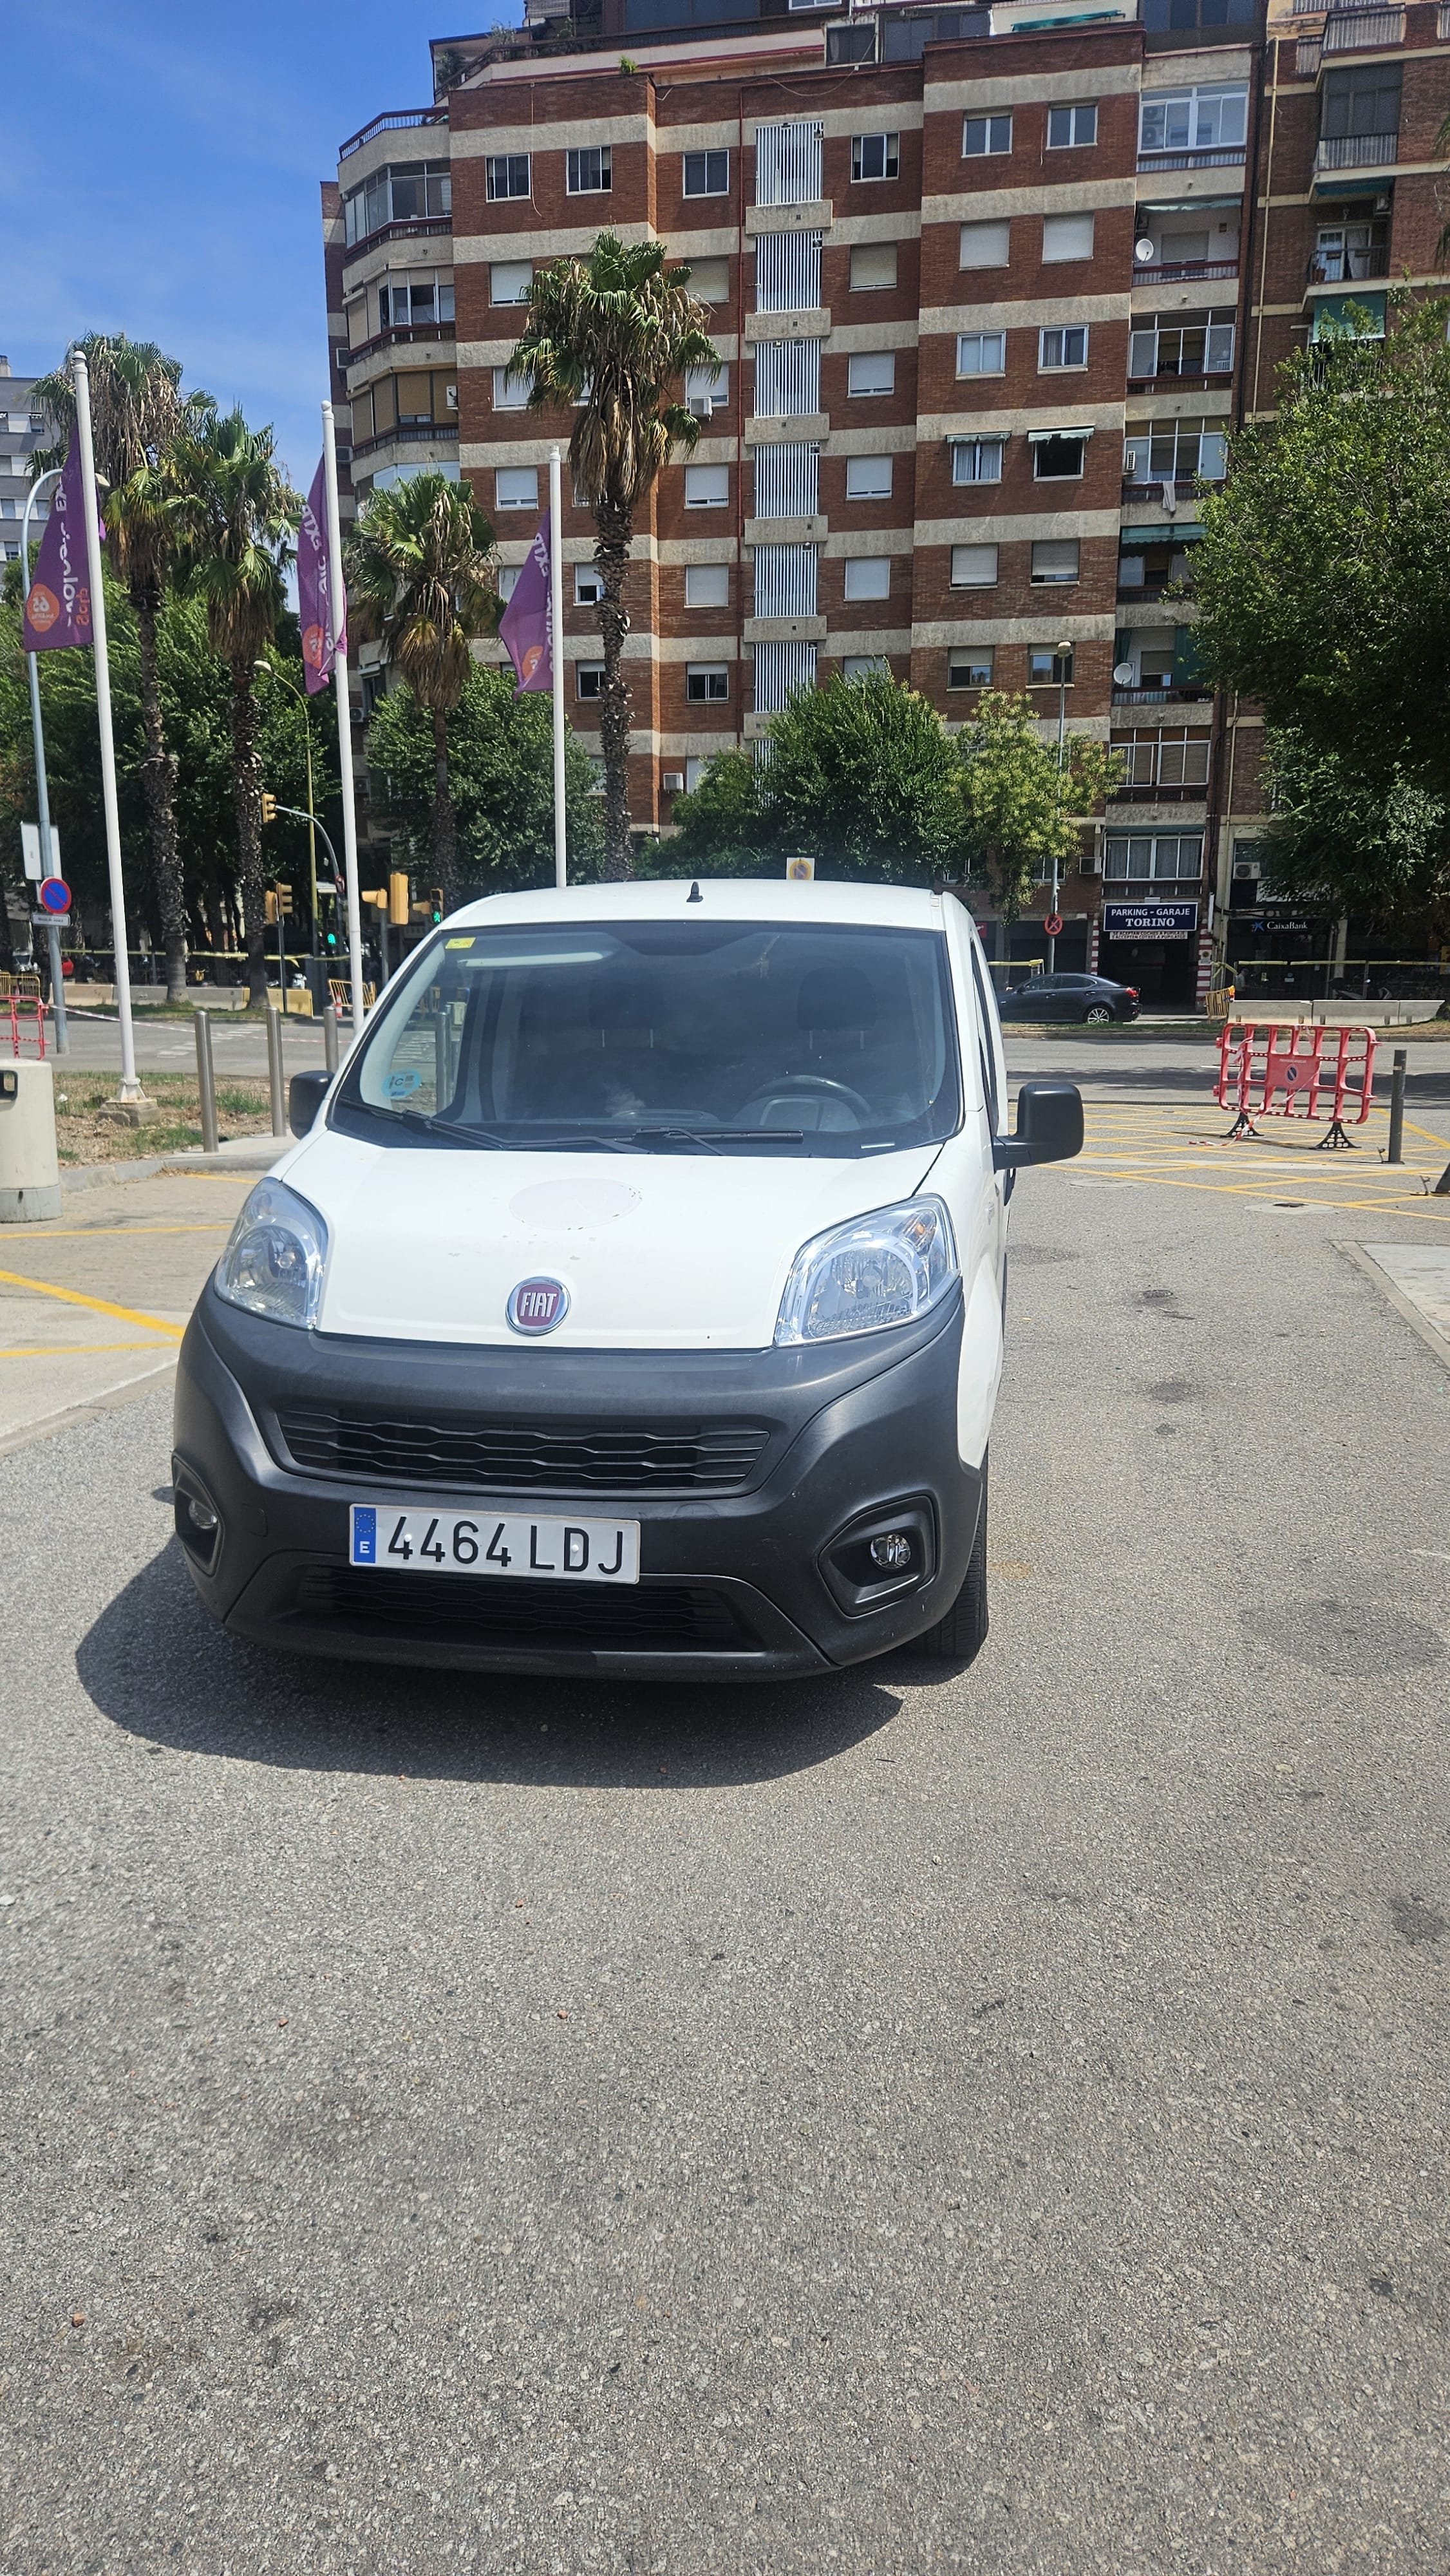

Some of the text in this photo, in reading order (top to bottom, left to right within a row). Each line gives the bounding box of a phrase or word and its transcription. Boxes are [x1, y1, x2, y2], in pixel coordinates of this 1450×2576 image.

[1125, 918, 1175, 927] TORINO
[1266, 921, 1308, 929] CaixaBank
[520, 1292, 557, 1318] FIAT
[359, 1541, 370, 1554] E
[388, 1515, 623, 1575] 4464 LDJ
